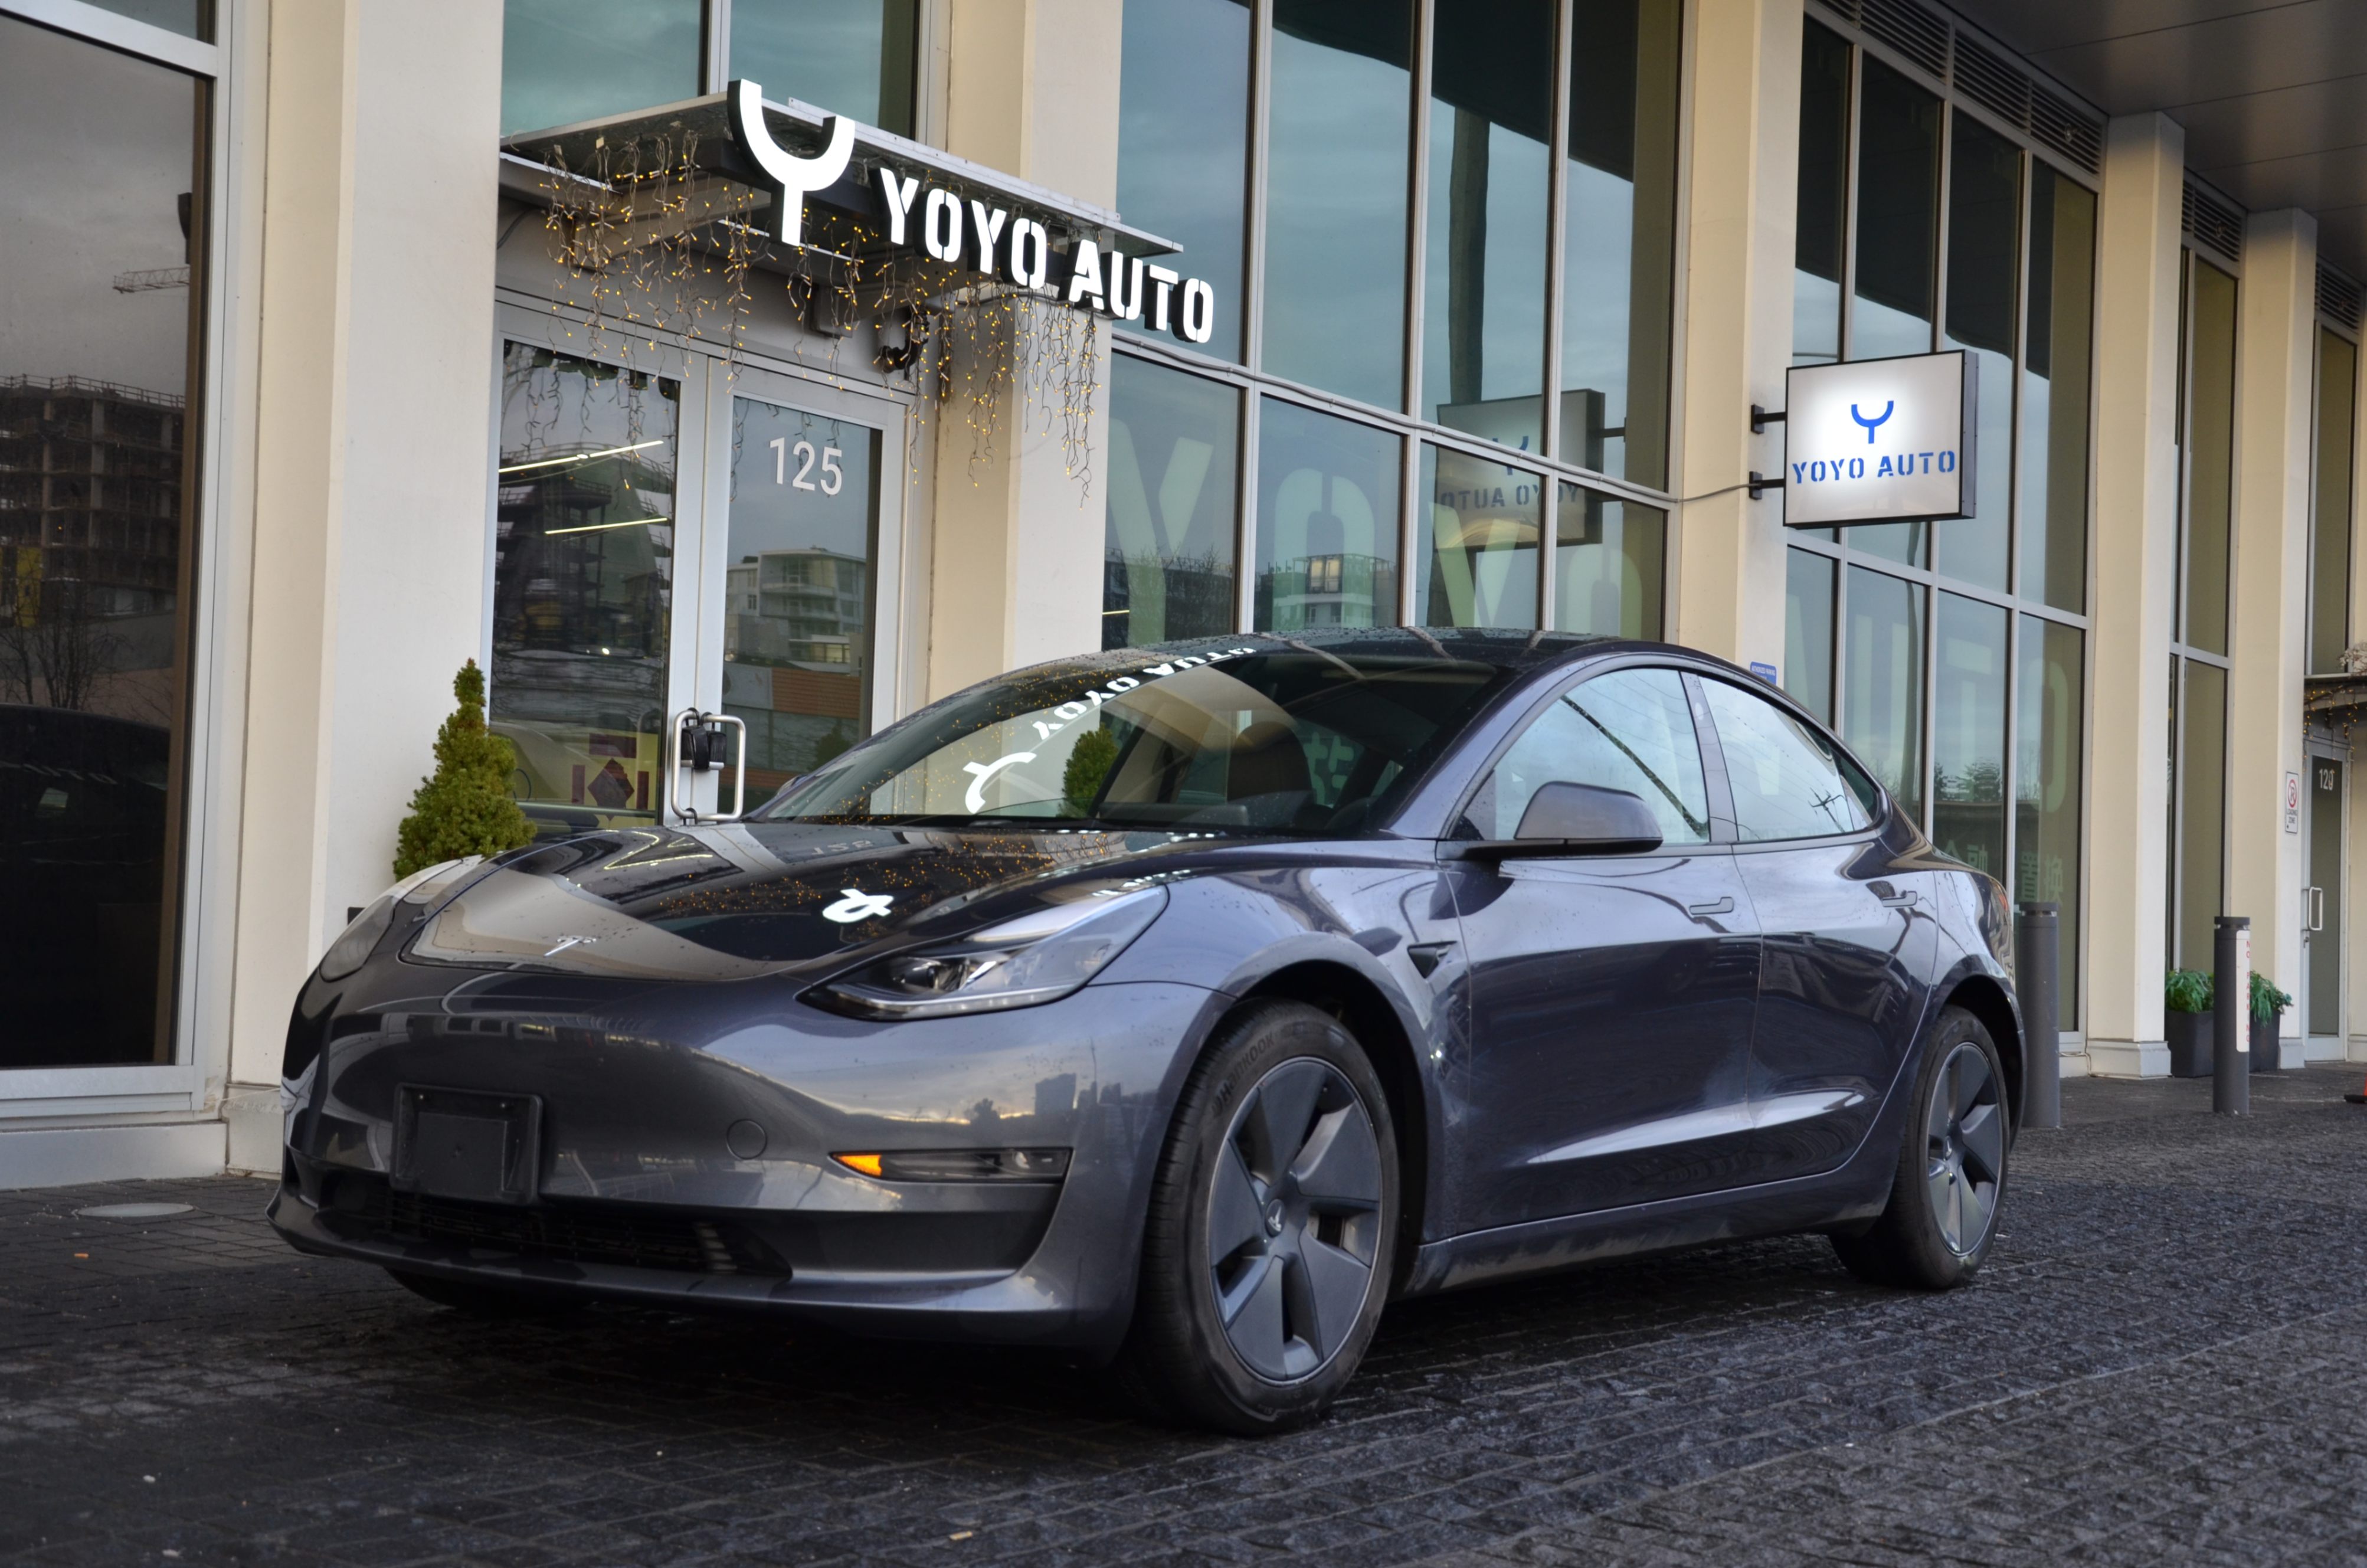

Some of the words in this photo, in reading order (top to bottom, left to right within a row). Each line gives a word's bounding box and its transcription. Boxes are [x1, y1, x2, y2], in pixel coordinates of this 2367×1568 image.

[879, 168, 1047, 289] YOYO
[1069, 240, 1214, 343] AUTO
[770, 437, 843, 495] 125
[1792, 457, 1865, 484] YOYO
[1877, 450, 1956, 477] AUTO
[2319, 768, 2334, 791] 120
